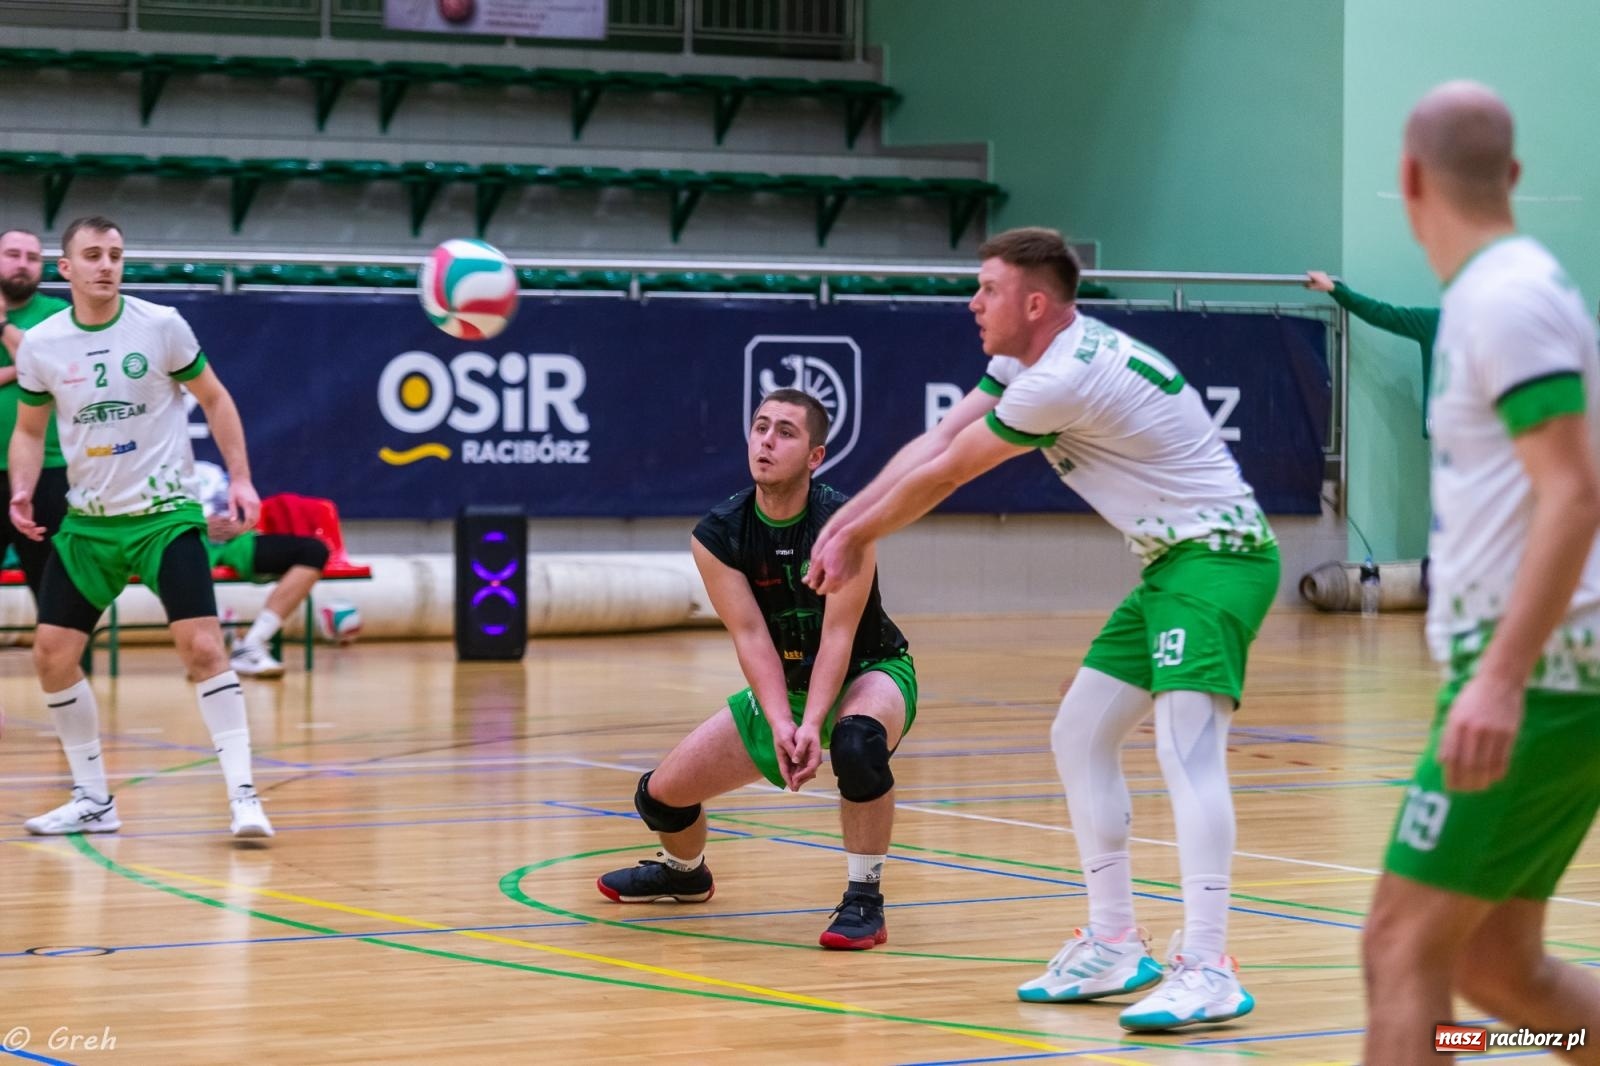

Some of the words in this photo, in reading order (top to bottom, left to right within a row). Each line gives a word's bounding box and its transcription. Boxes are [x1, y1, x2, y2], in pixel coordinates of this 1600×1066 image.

[94, 362, 109, 388] 2
[377, 351, 590, 434] OSiR
[461, 433, 590, 464] RACIBÓRZ
